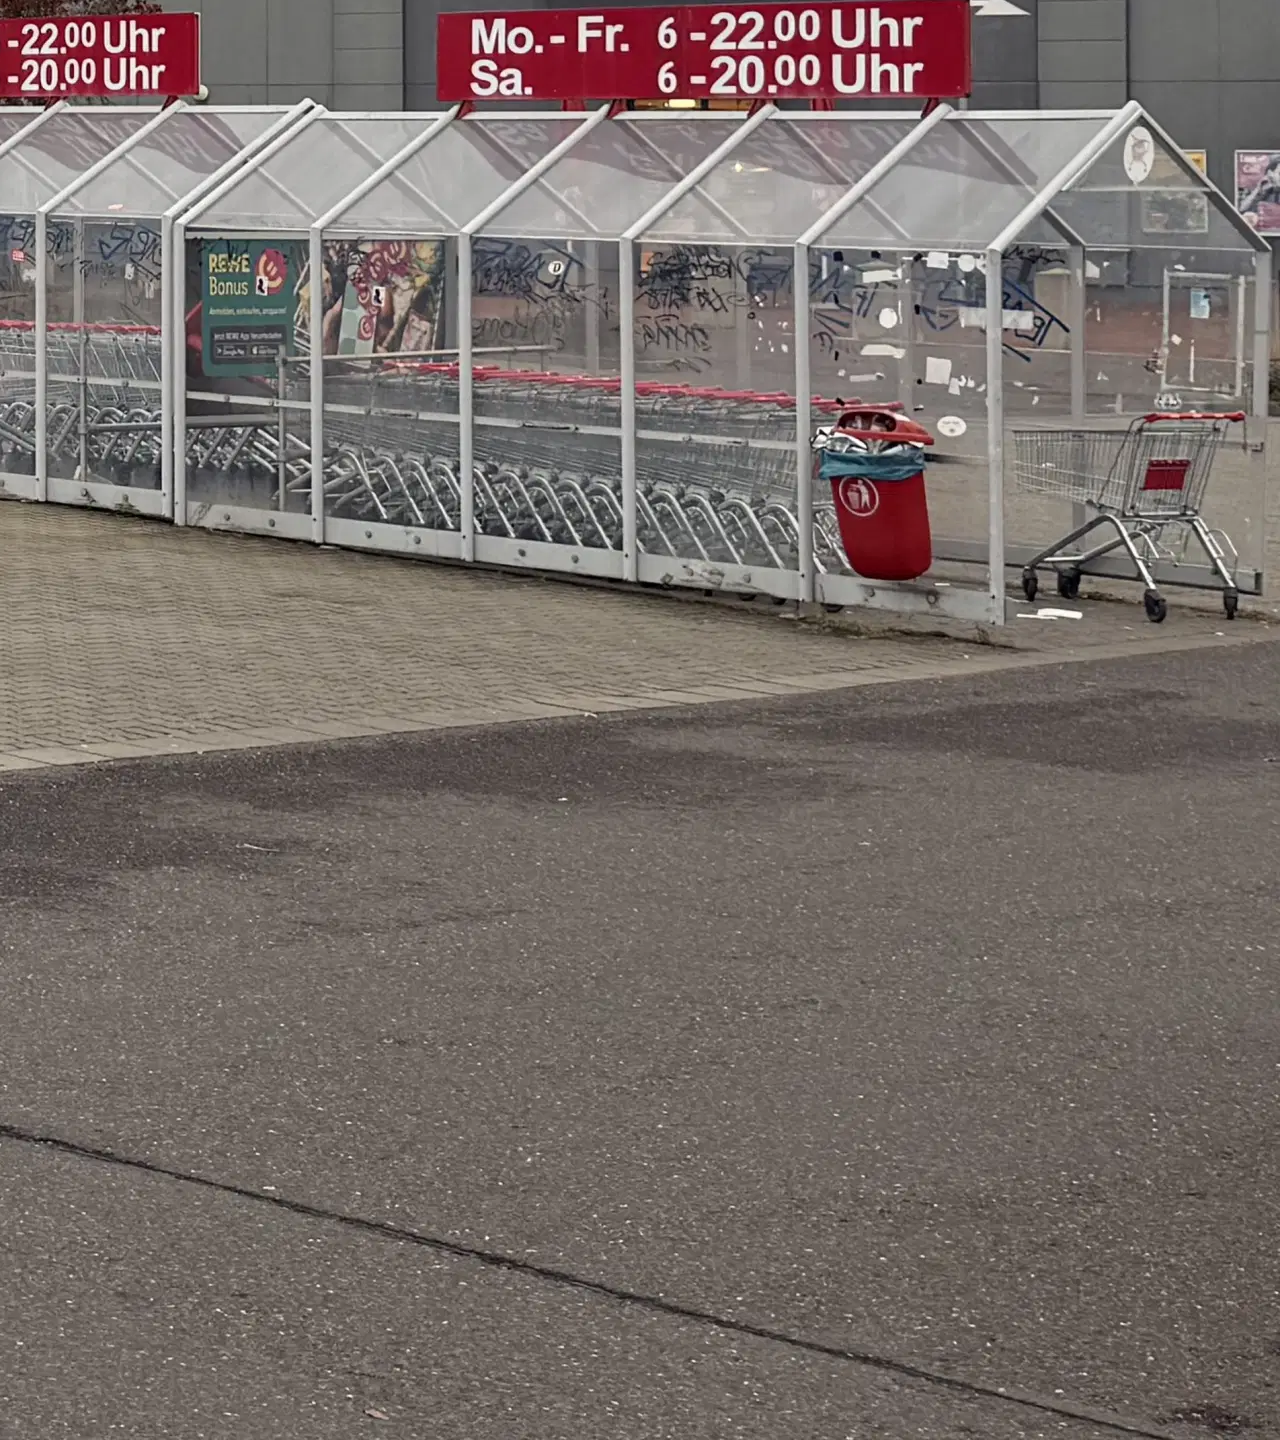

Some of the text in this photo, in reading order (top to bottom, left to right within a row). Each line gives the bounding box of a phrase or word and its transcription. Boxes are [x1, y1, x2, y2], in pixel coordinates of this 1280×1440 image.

[103, 20, 165, 54] Uhr
[577, 15, 630, 53] Fr.
[657, 17, 678, 50] 6
[831, 8, 923, 49] Uhr
[103, 57, 165, 90] Uhr
[470, 58, 533, 96] Sa.
[657, 61, 678, 93] 6
[831, 53, 924, 94] Uhr
[209, 276, 249, 296] Bonus
